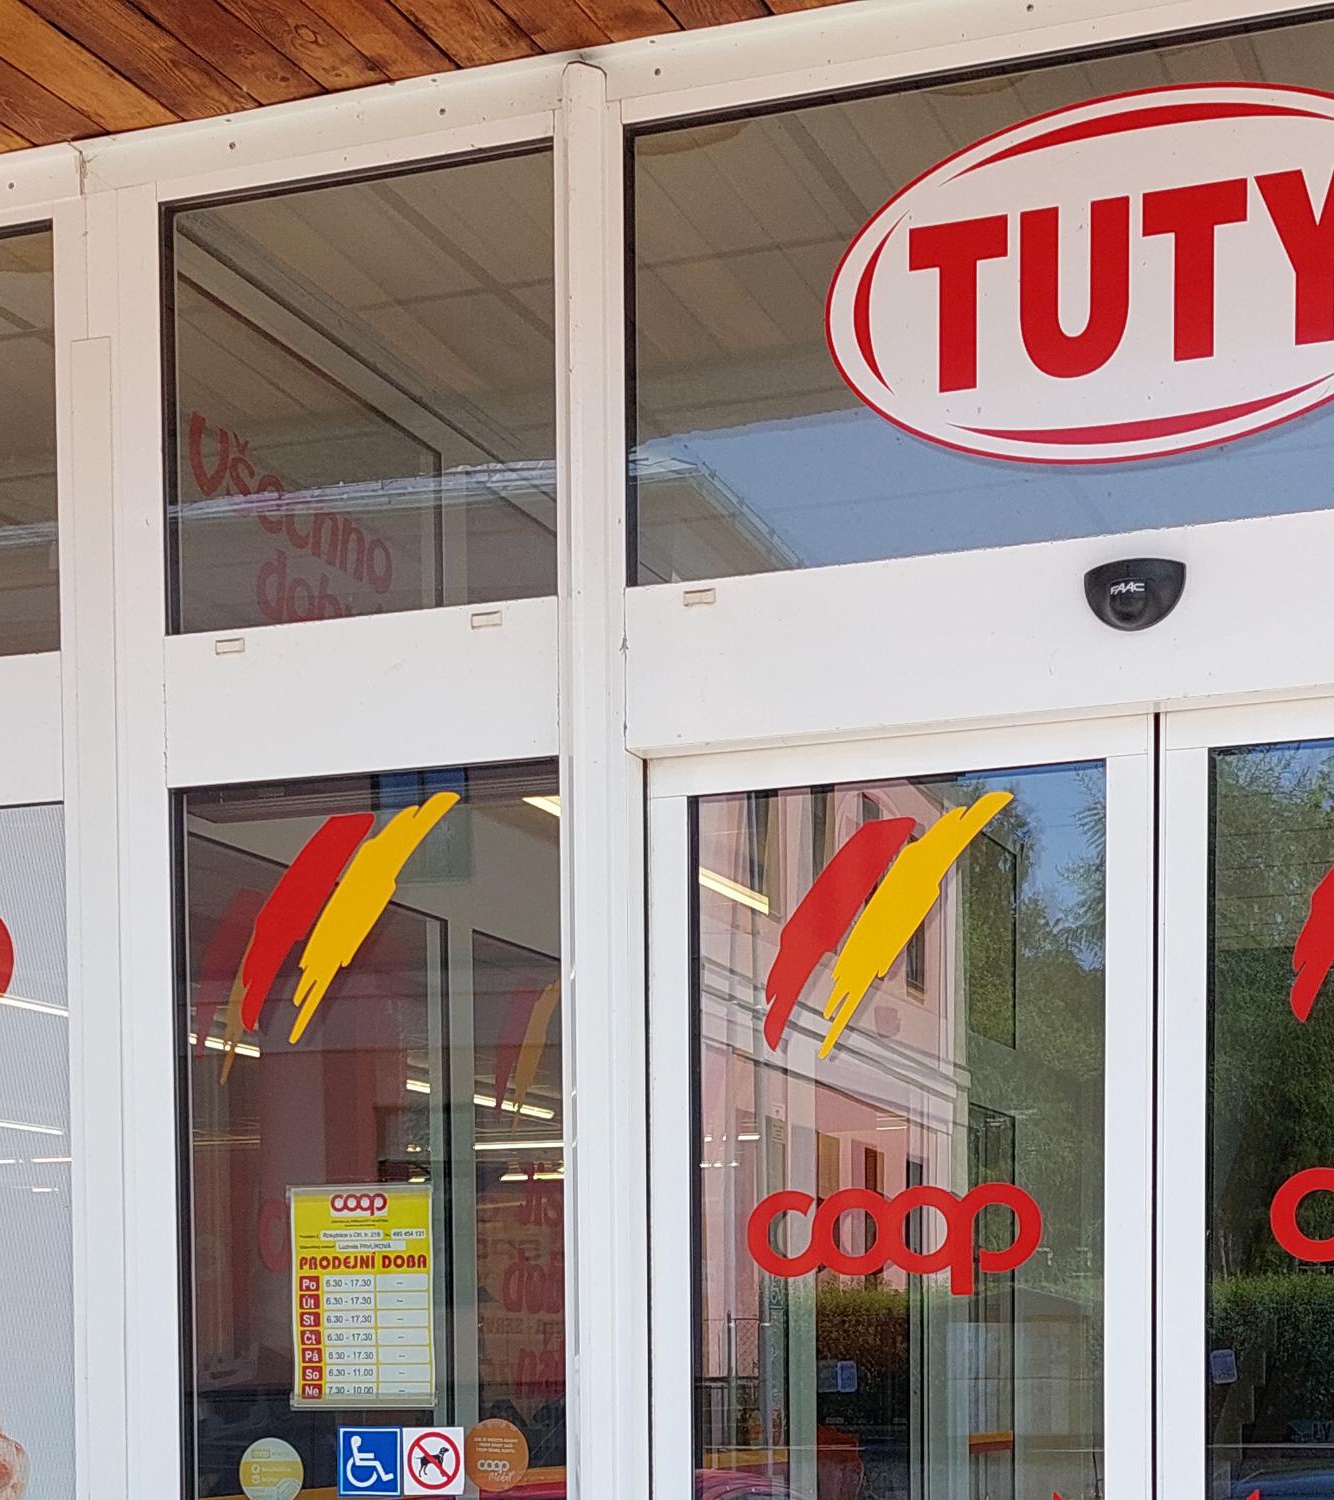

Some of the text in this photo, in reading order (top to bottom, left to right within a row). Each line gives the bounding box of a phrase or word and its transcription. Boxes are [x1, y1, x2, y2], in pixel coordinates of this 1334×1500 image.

[1110, 581, 1145, 595] FAAC
[330, 1193, 387, 1216] coop
[747, 1182, 1043, 1296] coop
[299, 1252, 428, 1270] PRODEJNÍ DOBA
[302, 1279, 317, 1290] Po
[302, 1296, 315, 1309] Út
[303, 1314, 315, 1326] St
[304, 1331, 316, 1344] Čt
[305, 1350, 319, 1362] Pá
[305, 1368, 320, 1379] So
[305, 1385, 319, 1397] Ne
